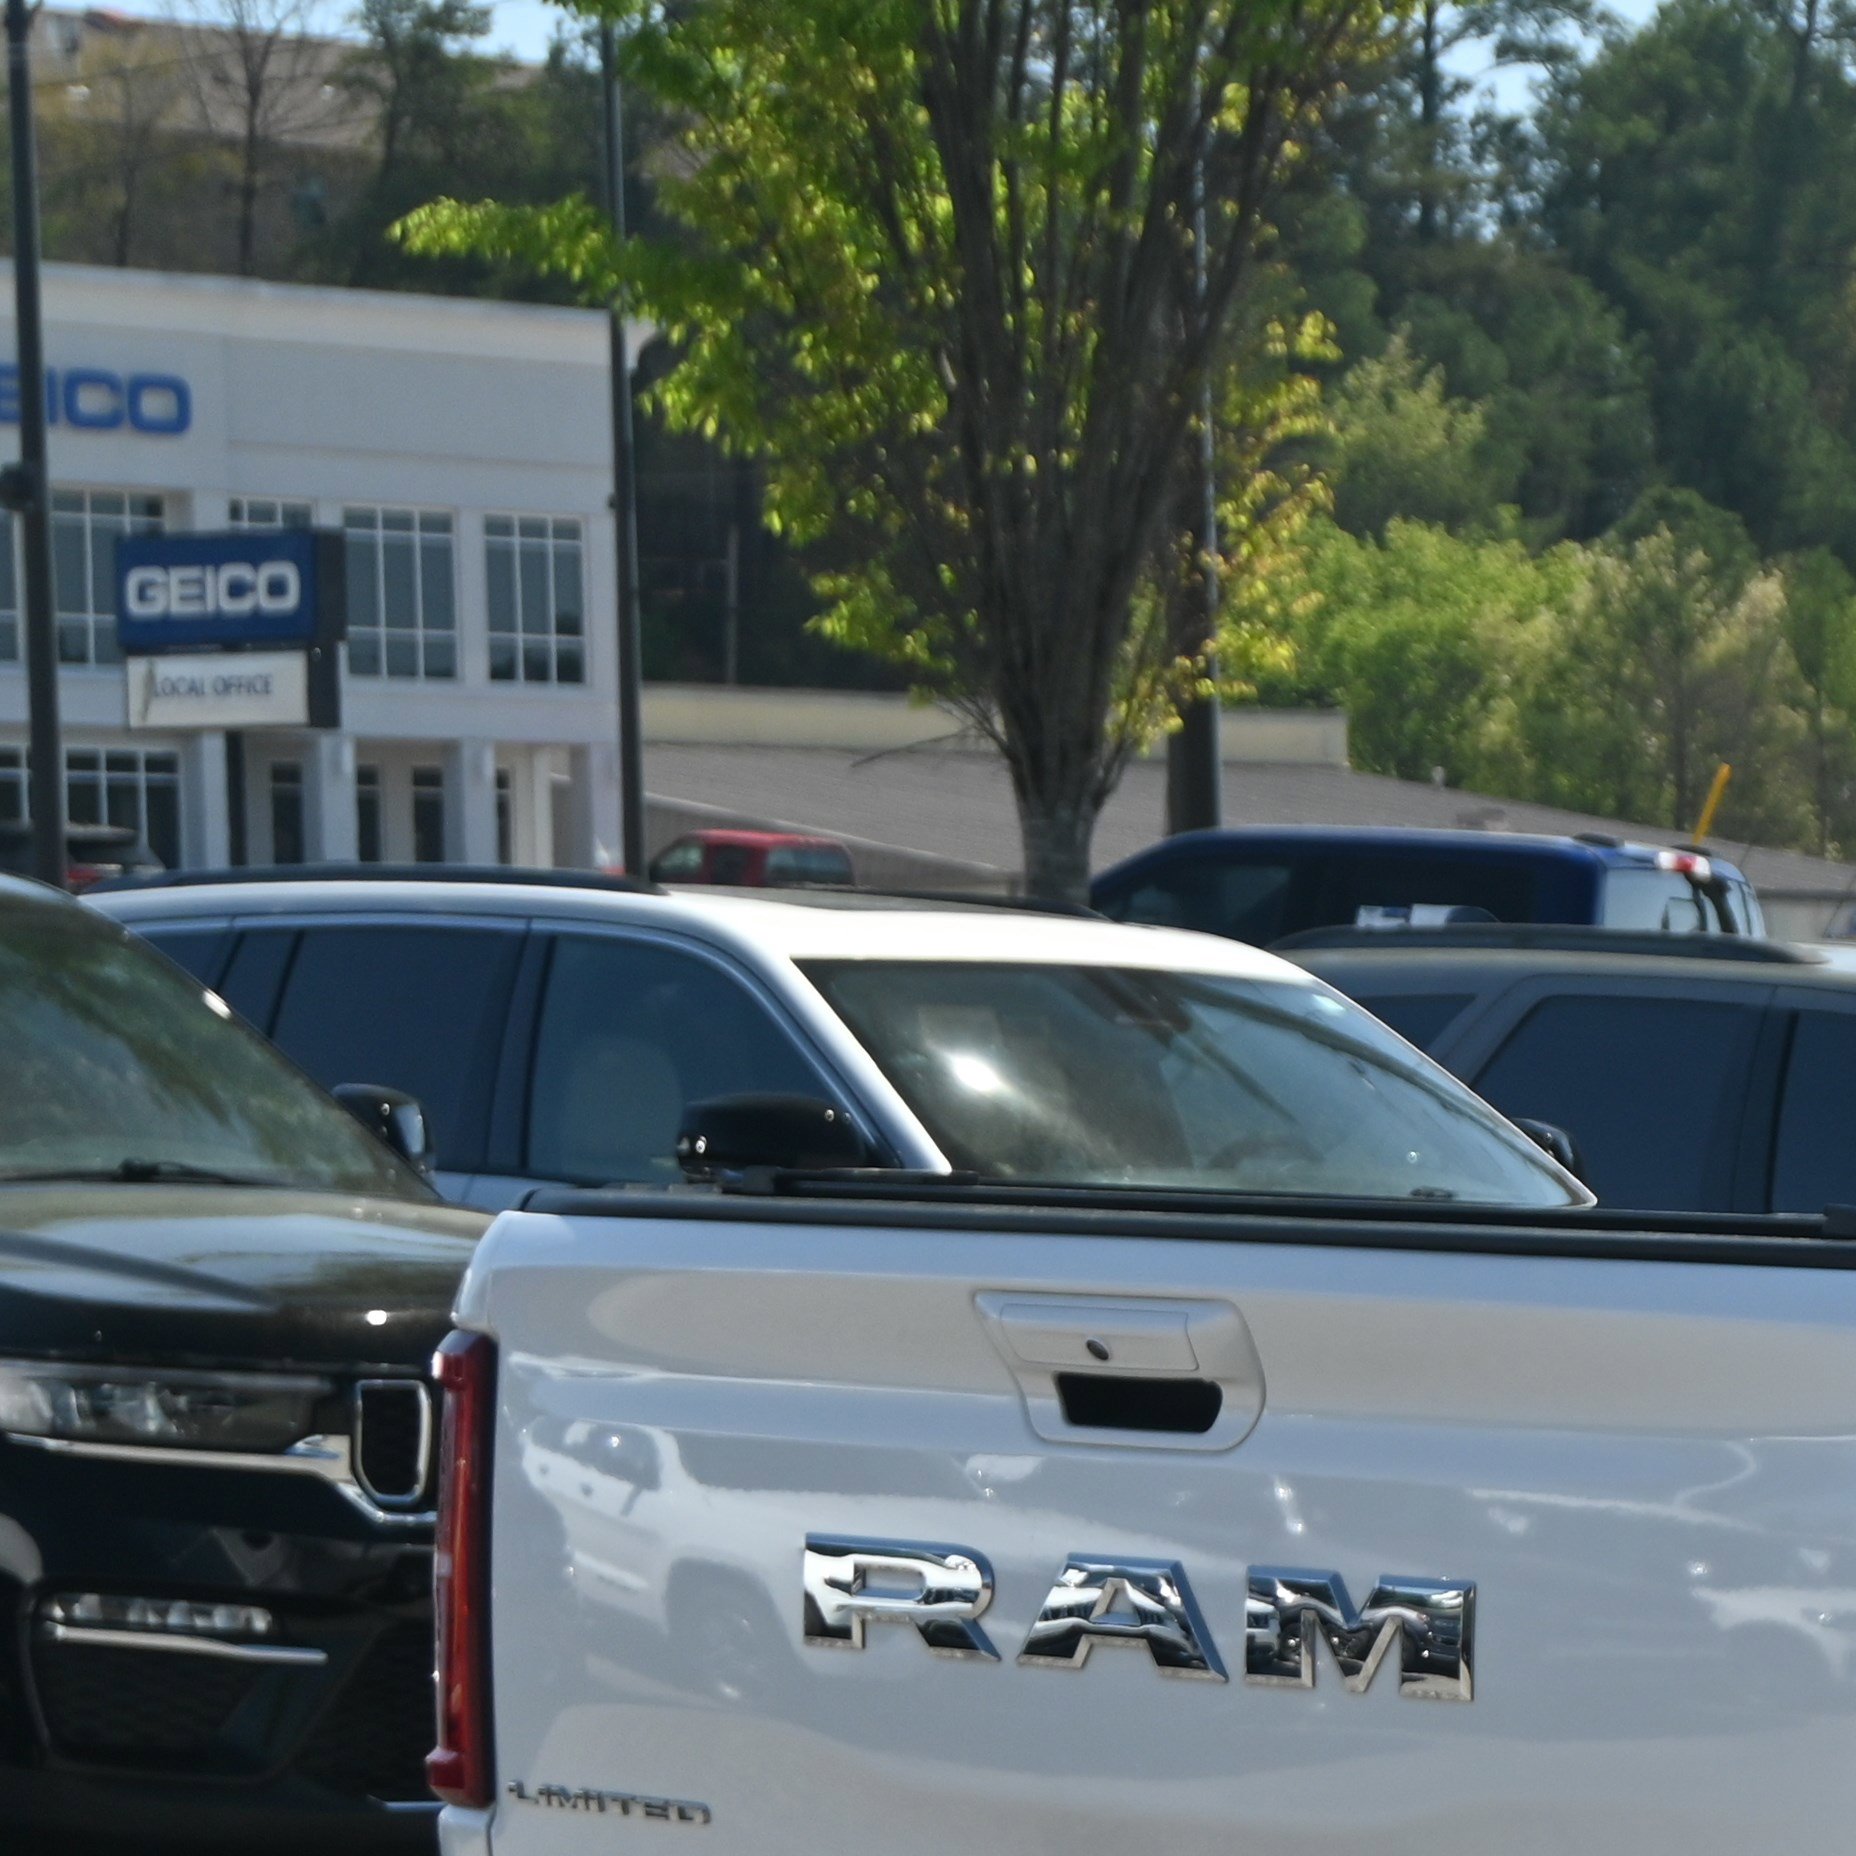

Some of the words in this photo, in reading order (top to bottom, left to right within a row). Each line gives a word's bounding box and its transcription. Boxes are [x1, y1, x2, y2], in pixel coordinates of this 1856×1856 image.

[126, 560, 300, 617] GEICO
[154, 675, 205, 697] LOCAL
[213, 673, 273, 696] OFFICE
[802, 1531, 1476, 1703] RAM
[507, 1779, 712, 1825] LIMITED
